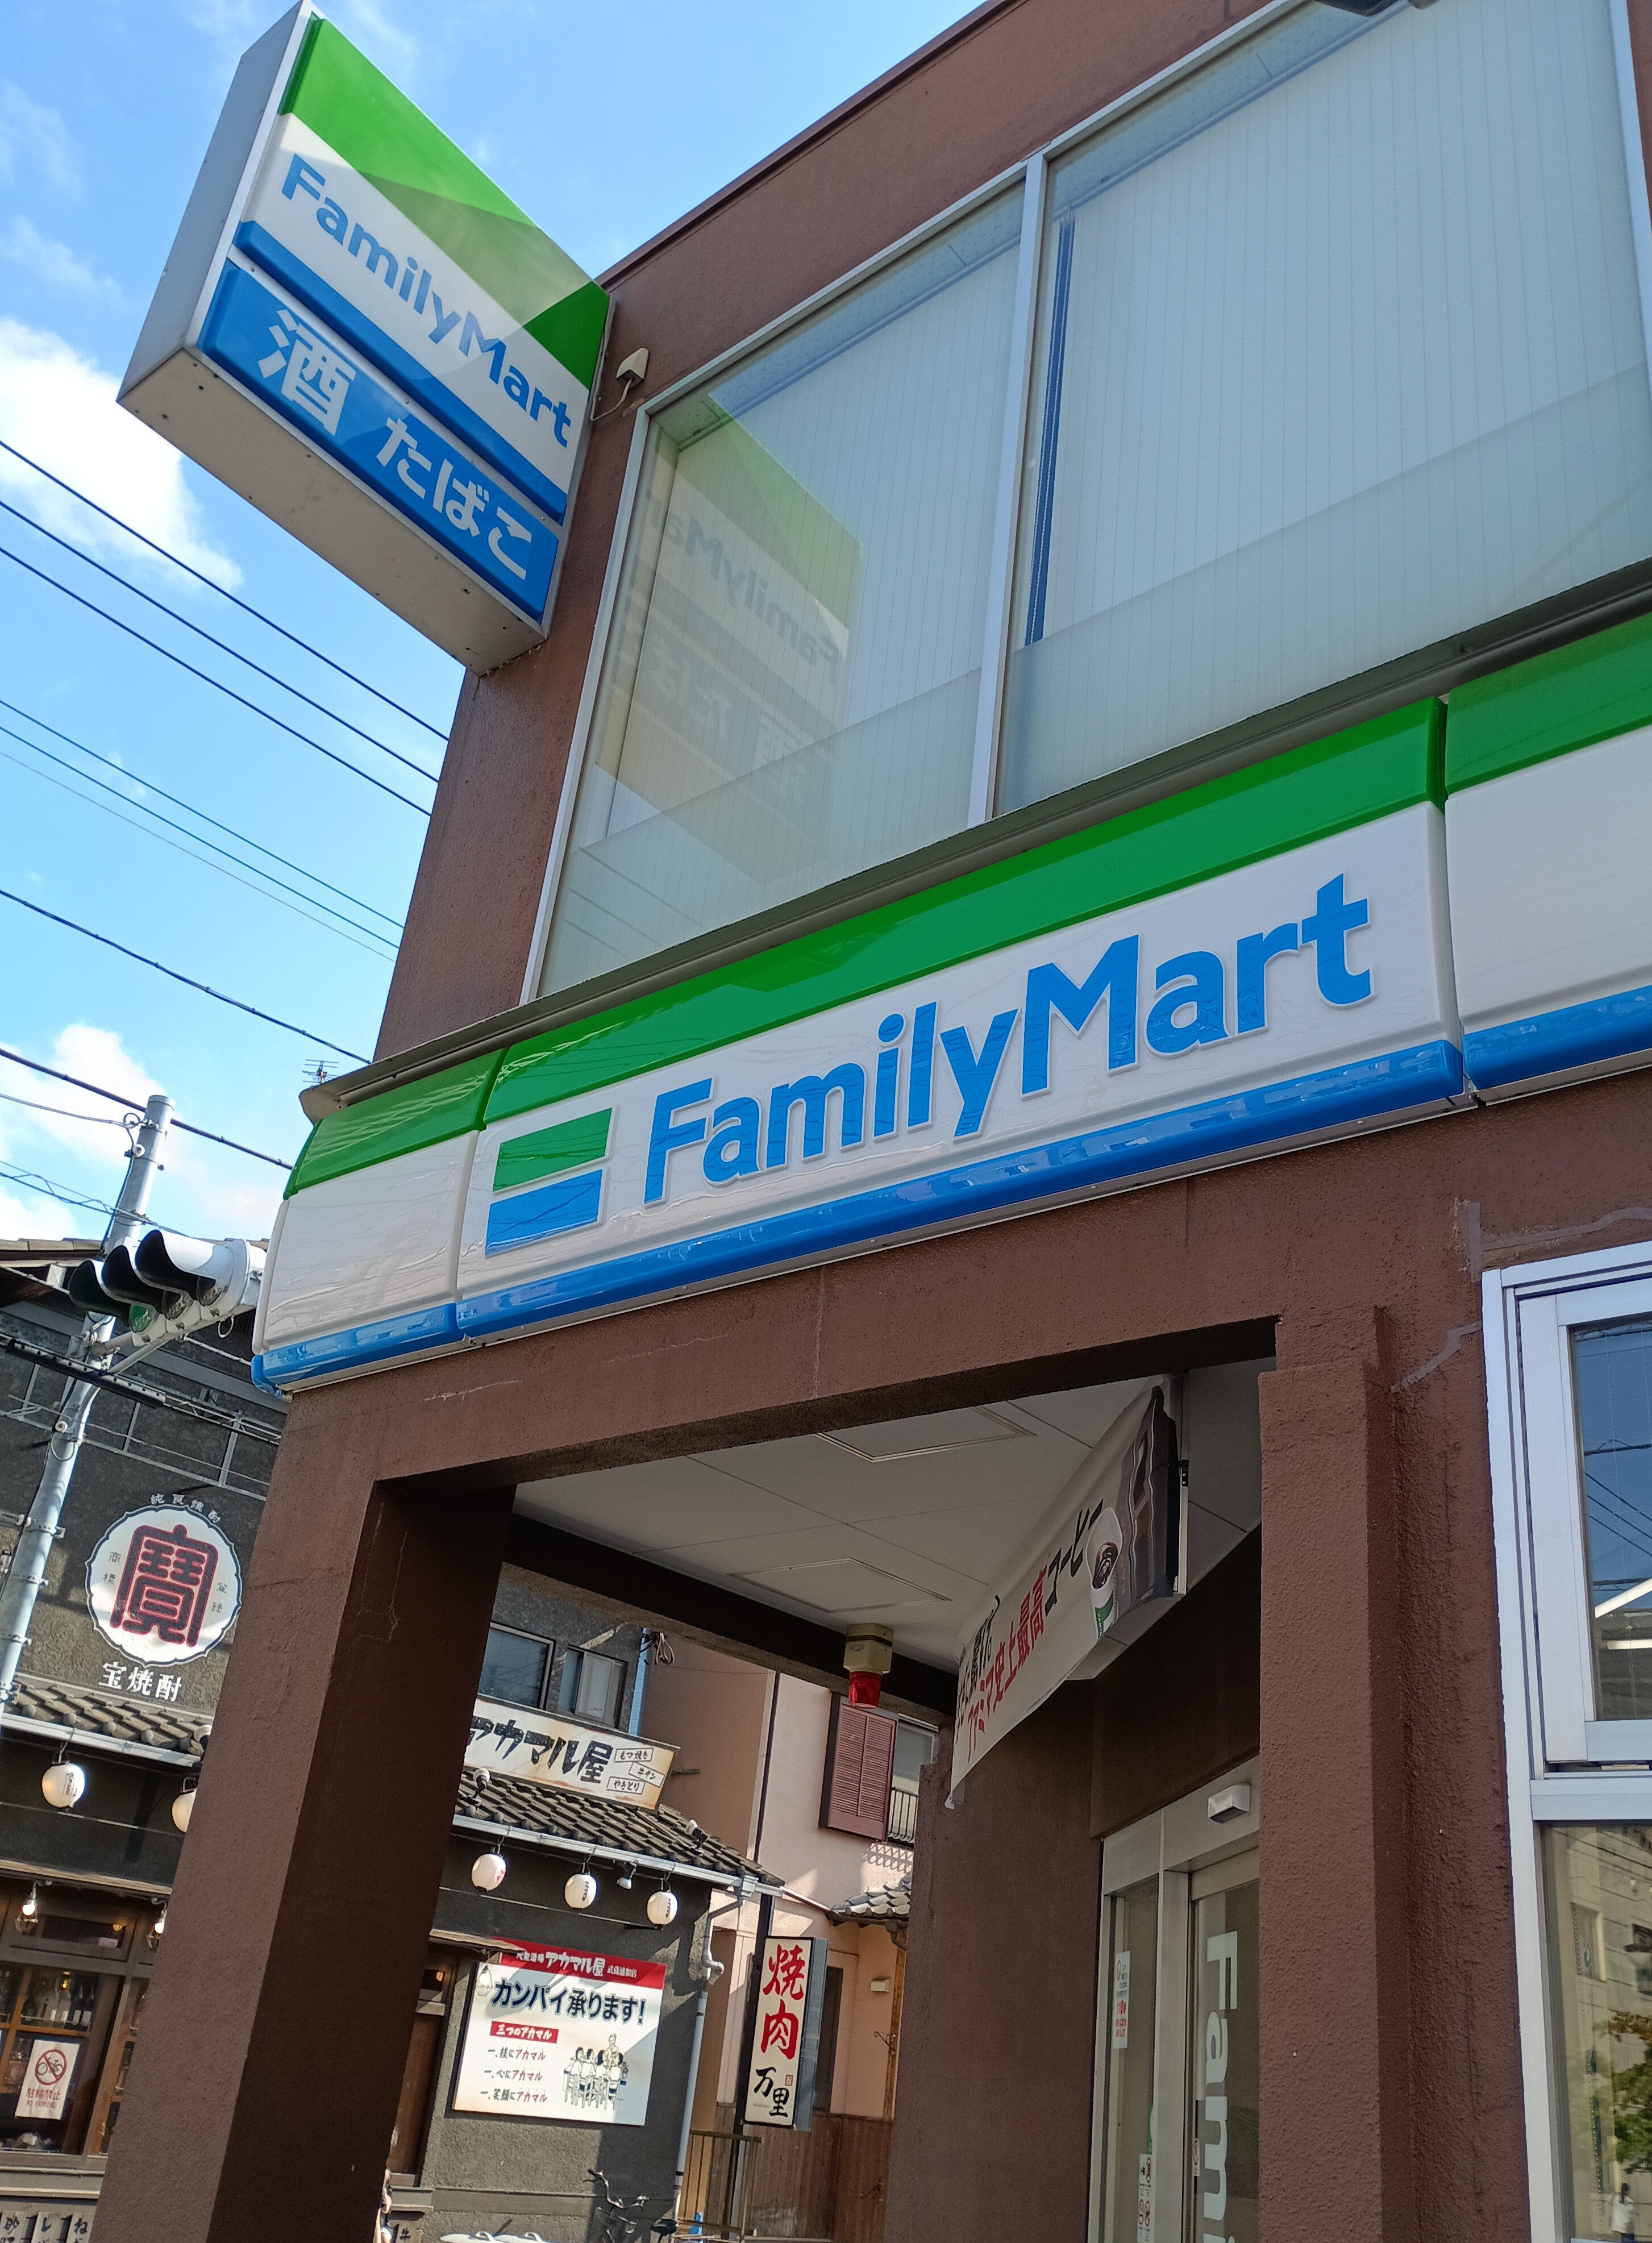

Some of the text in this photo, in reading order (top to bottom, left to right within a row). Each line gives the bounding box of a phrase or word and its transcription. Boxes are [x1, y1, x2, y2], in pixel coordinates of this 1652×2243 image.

[281, 154, 572, 448] FamilyMart
[257, 309, 532, 581] 酒 たばこ
[644, 873, 1371, 1205] FamilyMart
[98, 1662, 182, 1702] 宝焼酎
[614, 1780, 640, 1791] やきとり
[546, 1951, 606, 1977] アカマル屋
[761, 1944, 806, 2060] 焼肉
[496, 2024, 552, 2040] 三つのアカマル
[754, 2067, 790, 2118] 万里
[74, 2217, 88, 2243] ね
